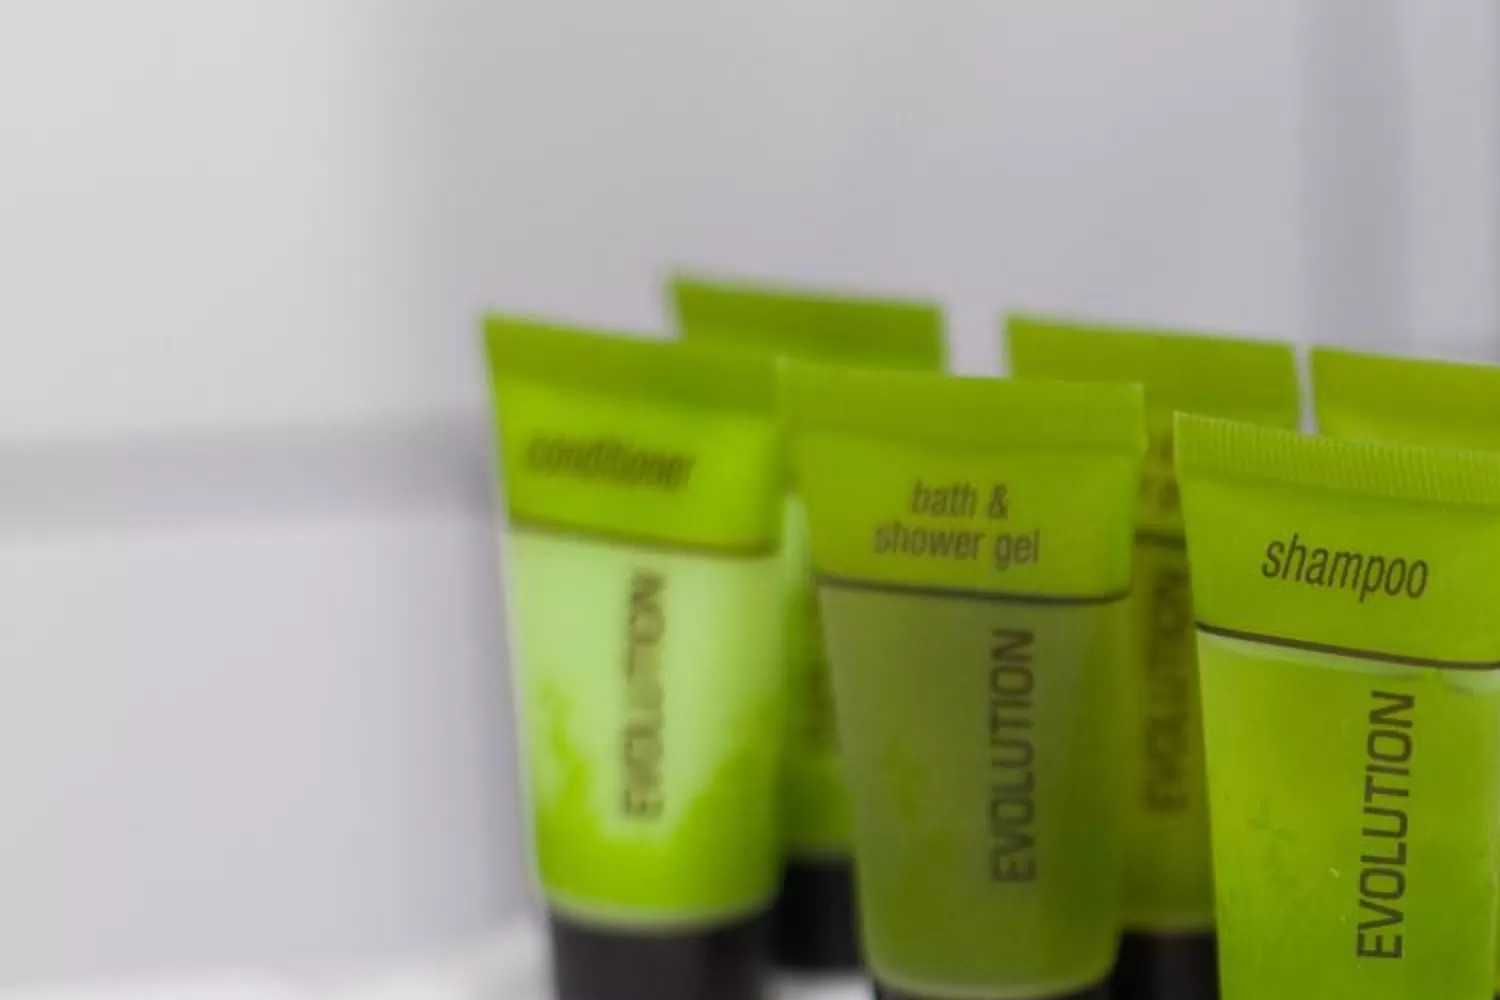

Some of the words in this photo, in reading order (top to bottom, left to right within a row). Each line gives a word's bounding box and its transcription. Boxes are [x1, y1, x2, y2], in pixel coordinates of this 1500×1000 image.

[528, 431, 697, 490] conditioner
[911, 479, 978, 518] bath
[987, 482, 1009, 520] &
[874, 520, 986, 561] shower
[994, 529, 1041, 572] gel
[1261, 534, 1429, 603] shampoo
[622, 568, 667, 820] EVOLUTION
[989, 627, 1038, 885] EVOLUTION
[1356, 689, 1416, 960] EVOLUTION
